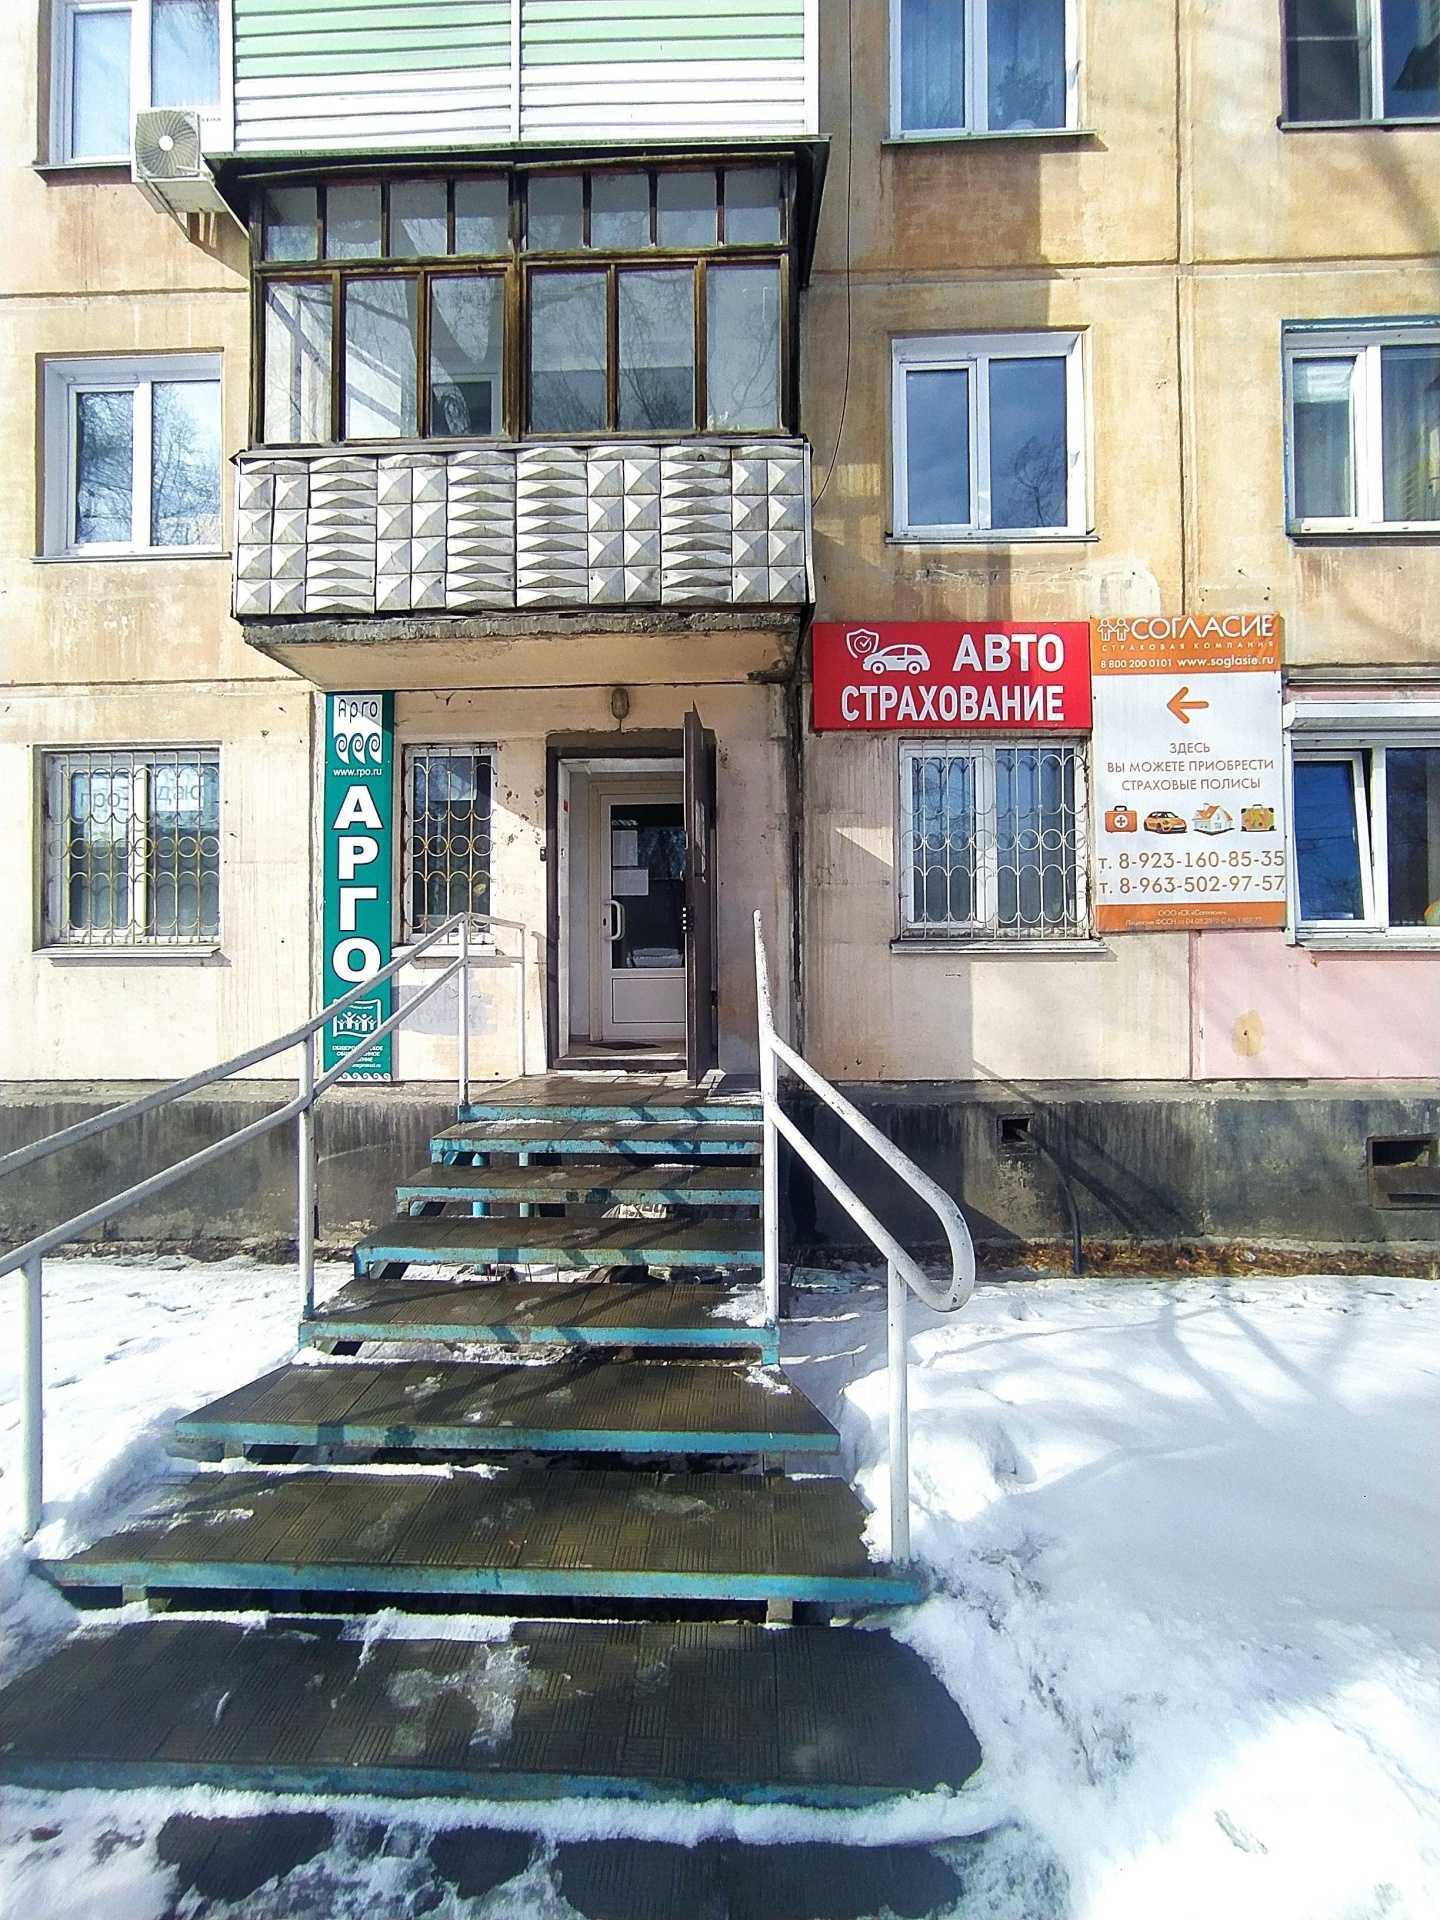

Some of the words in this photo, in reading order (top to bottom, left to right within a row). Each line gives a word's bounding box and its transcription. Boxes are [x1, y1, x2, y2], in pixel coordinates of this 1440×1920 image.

[1131, 614, 1273, 640] СОГЛАСИЕ
[952, 633, 1065, 672] АВТО
[1102, 643, 1185, 652] СТРАХОВАЯ
[1194, 640, 1273, 650] КОМПАНИЯ
[1177, 654, 1275, 669] www.soglasie.ru
[338, 698, 378, 724] Арго
[841, 685, 1065, 721] СТРАХОВАНИЕ
[1169, 742, 1211, 754] ЗДЕСЬ
[333, 768, 382, 778] www.rpo.ru
[1107, 761, 1125, 773] ВЫ
[1129, 760, 1185, 773] МОЖЕТЕ
[1189, 759, 1274, 772] ПРИОБРЕСТИ
[1121, 779, 1197, 791] СТРАХОВЫЕ
[1201, 778, 1261, 790] ПОЛИСЫ
[1119, 850, 1285, 870] 8-923-160-85-35
[333, 785, 384, 983] АРГО
[1119, 874, 1285, 895] 8-963-502-97-57
